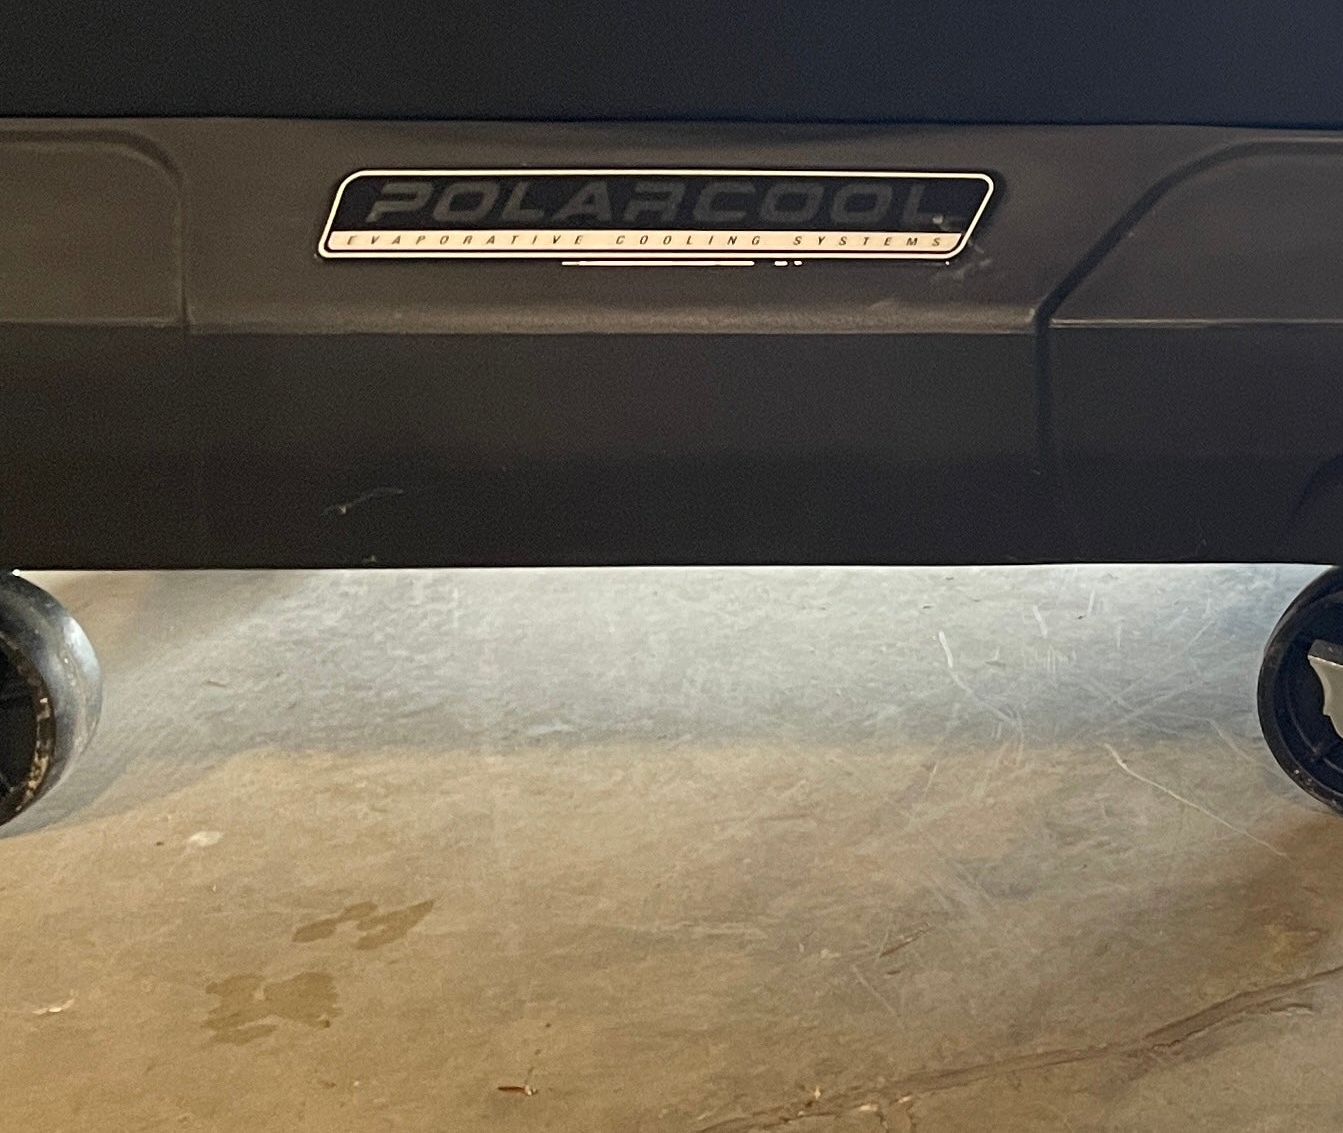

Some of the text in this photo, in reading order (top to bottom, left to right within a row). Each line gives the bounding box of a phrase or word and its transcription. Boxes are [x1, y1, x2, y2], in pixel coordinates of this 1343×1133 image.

[365, 180, 954, 225] POLARCOOL
[346, 234, 942, 248] EVAPORATIVE COOLING SYSTEMS
